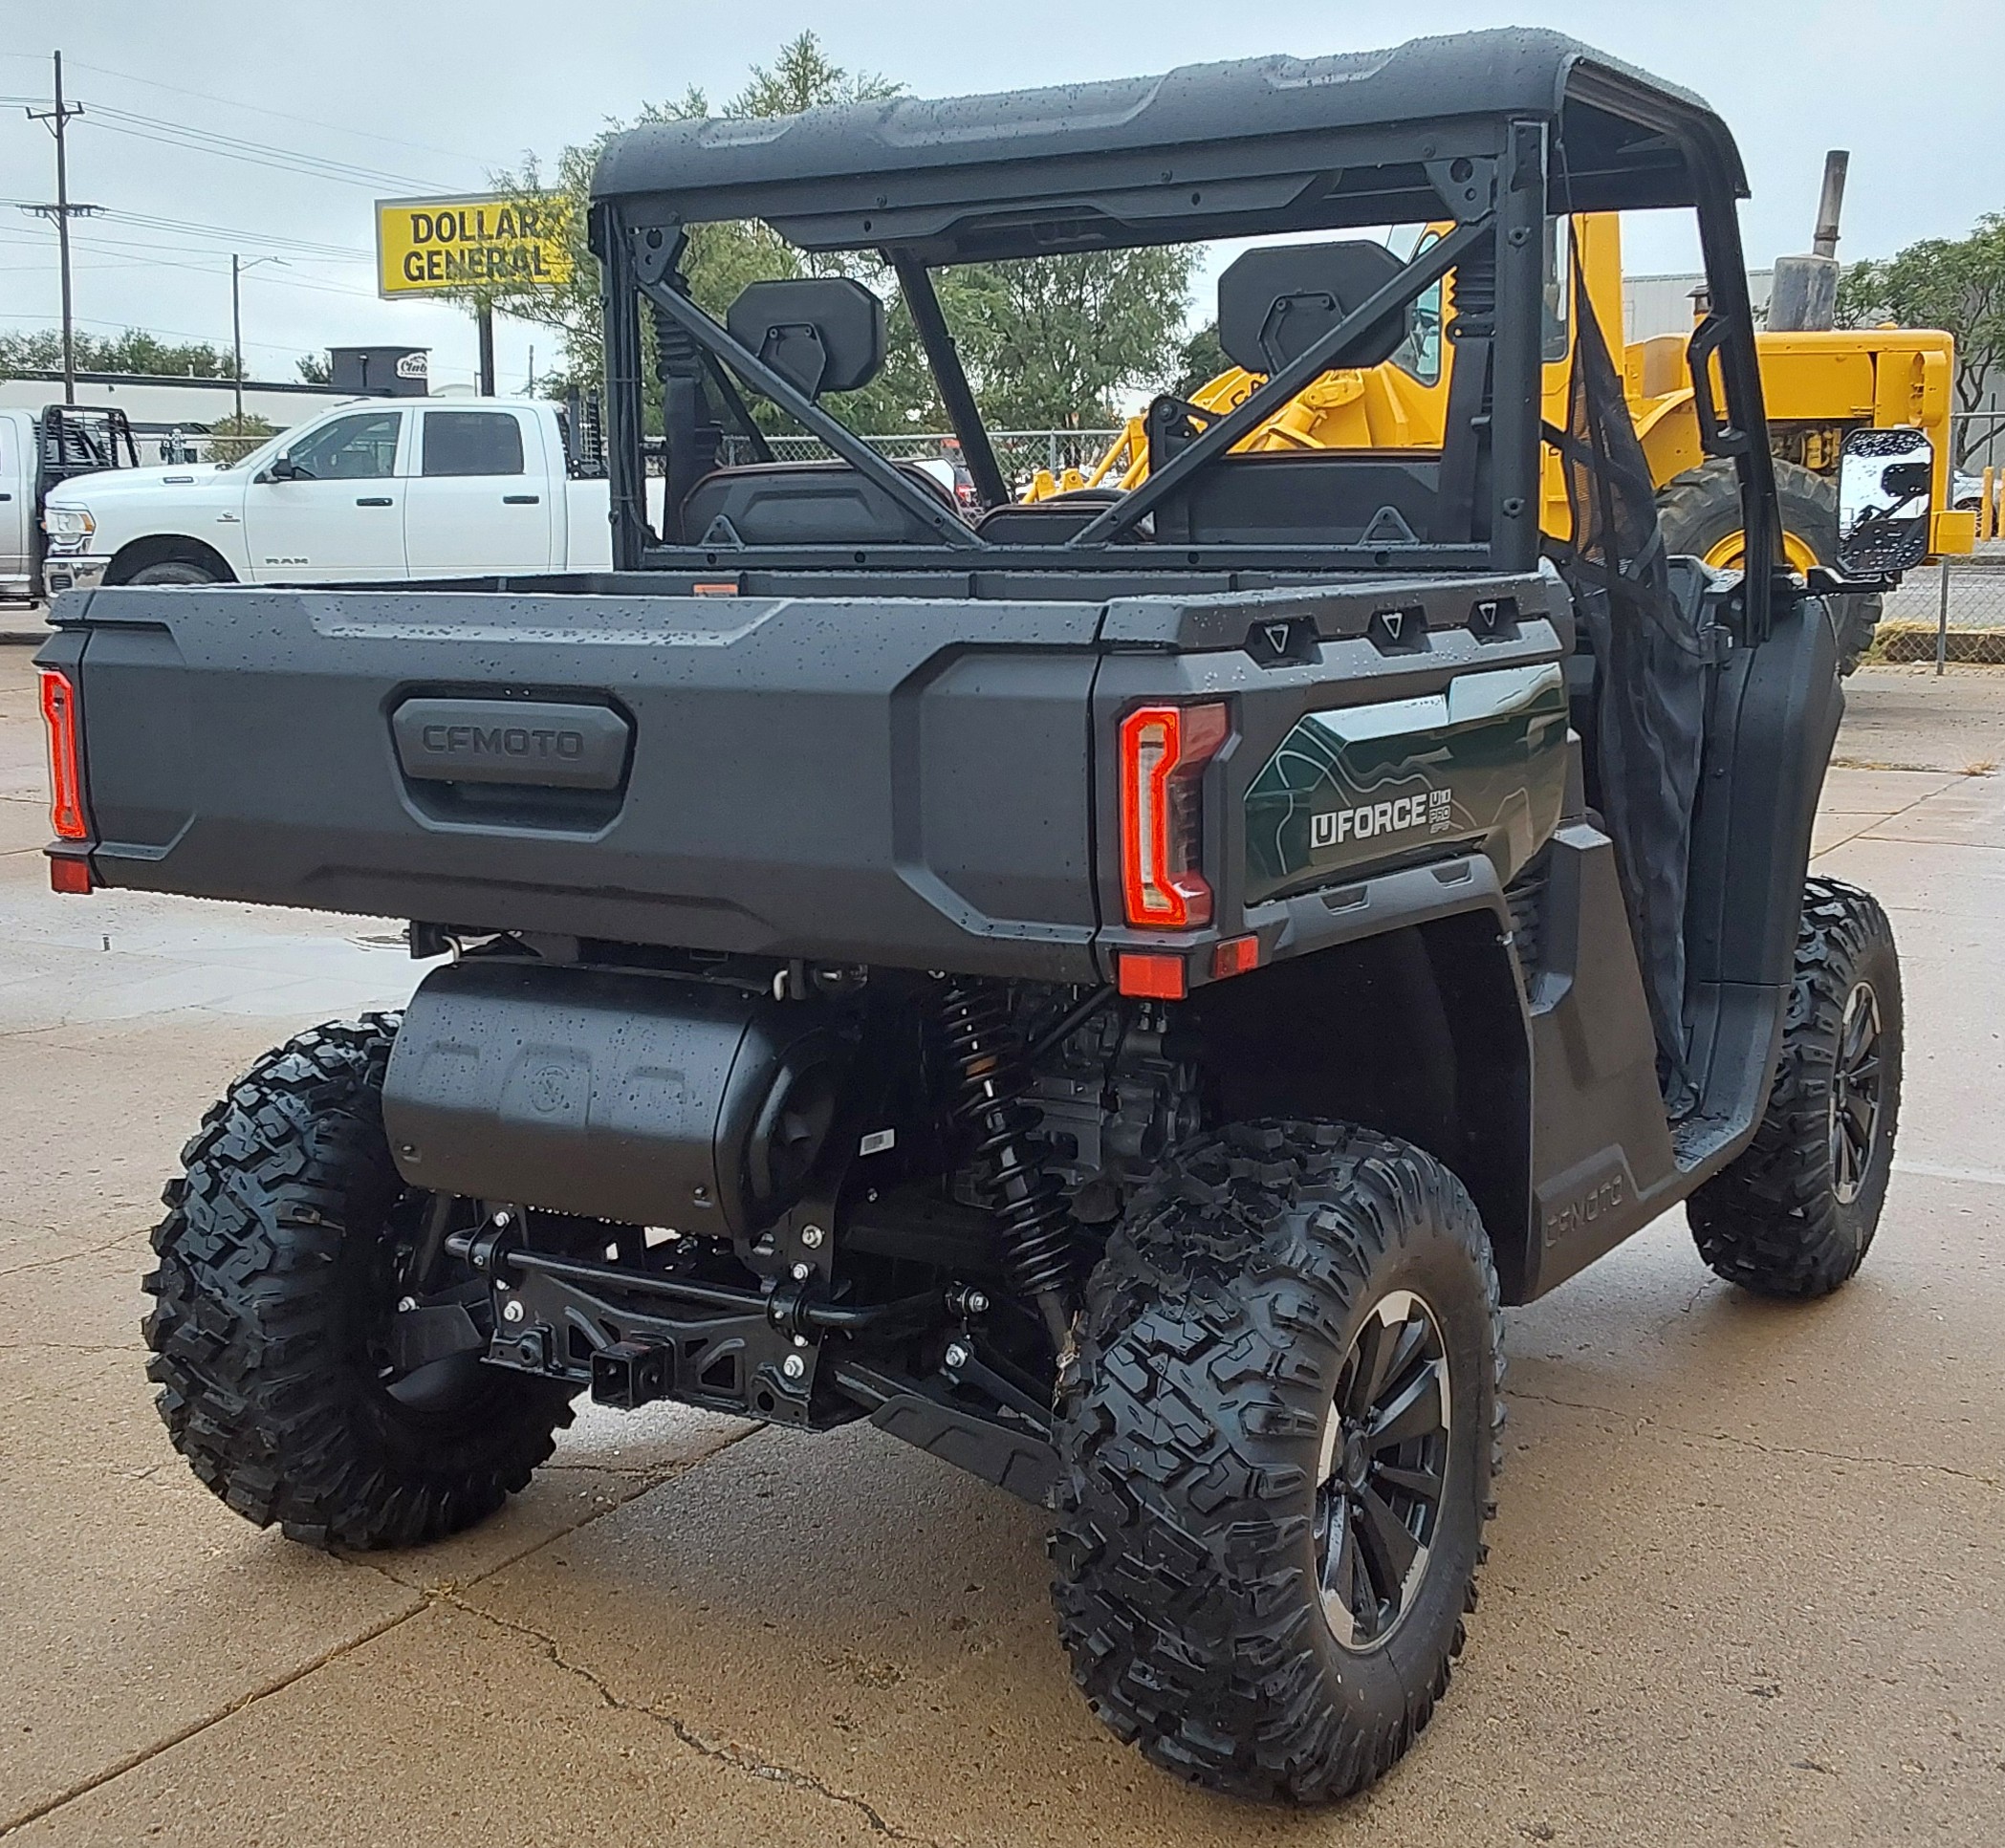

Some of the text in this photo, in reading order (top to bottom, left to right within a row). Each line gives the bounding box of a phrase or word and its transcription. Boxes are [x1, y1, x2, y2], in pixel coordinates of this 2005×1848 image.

[410, 207, 542, 244] DOLLAR
[403, 244, 551, 282] GENERAL
[423, 724, 584, 762] CFMOTO
[1310, 794, 1427, 849] UFORCE
